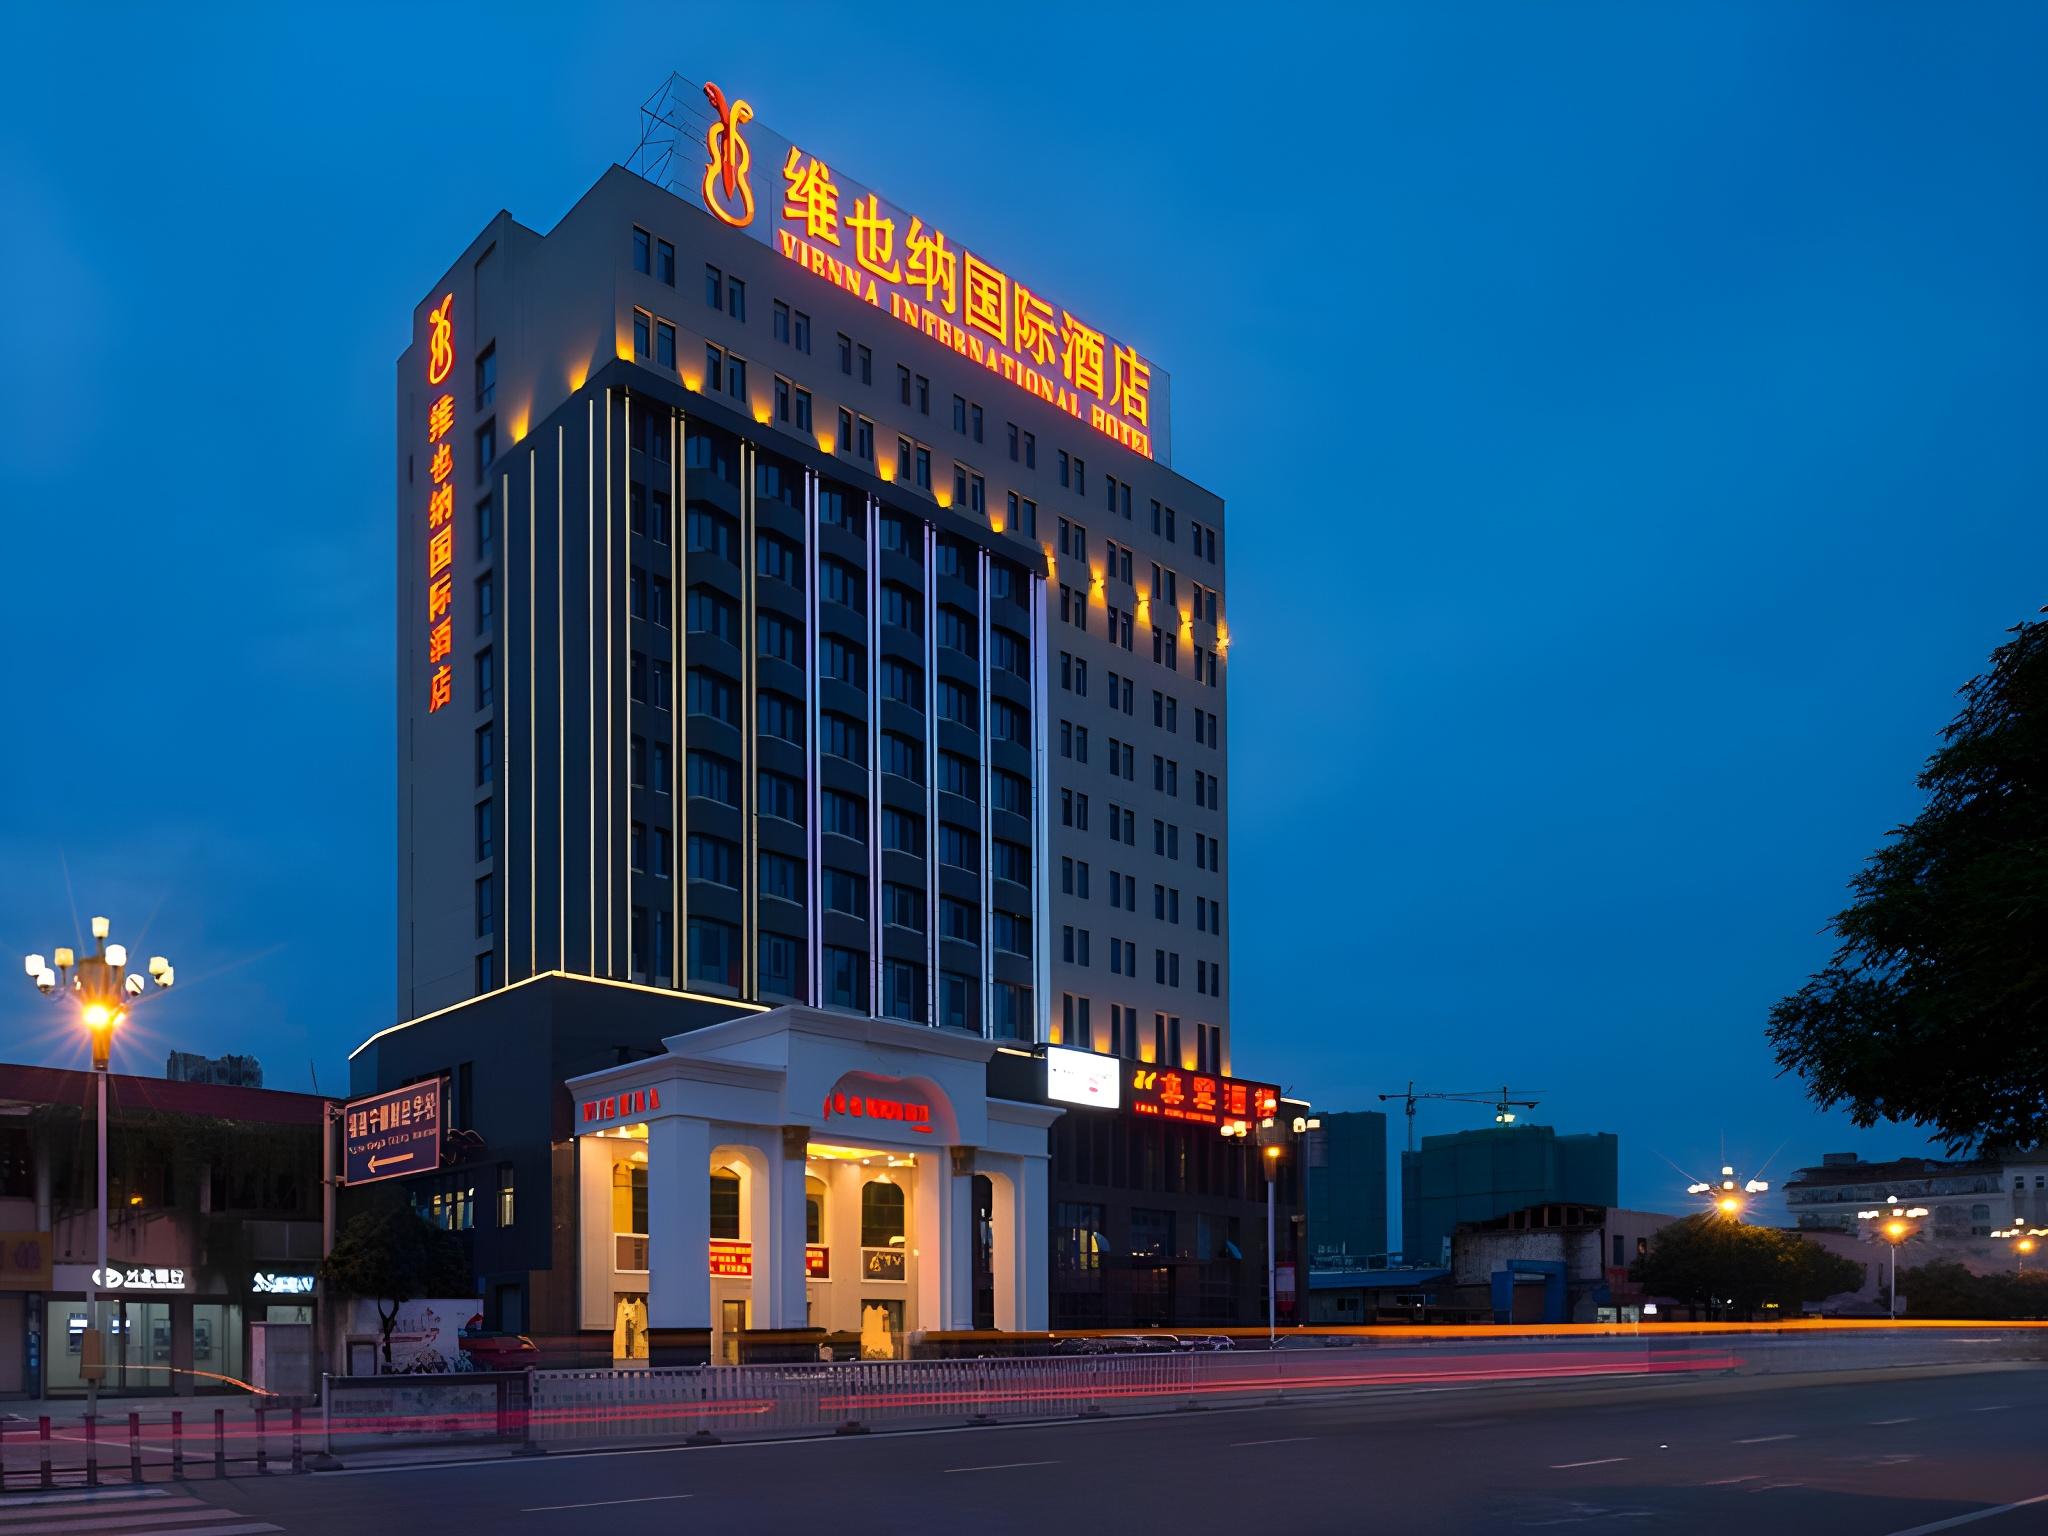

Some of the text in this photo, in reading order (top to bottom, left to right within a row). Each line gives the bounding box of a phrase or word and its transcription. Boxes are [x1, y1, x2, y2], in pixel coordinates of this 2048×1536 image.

[778, 228, 880, 308] VIENNA
[889, 291, 1082, 418] INTERNATIONAL
[782, 145, 1151, 428] 维也纳国际酒店
[429, 394, 455, 714] 维也纳国际酒店
